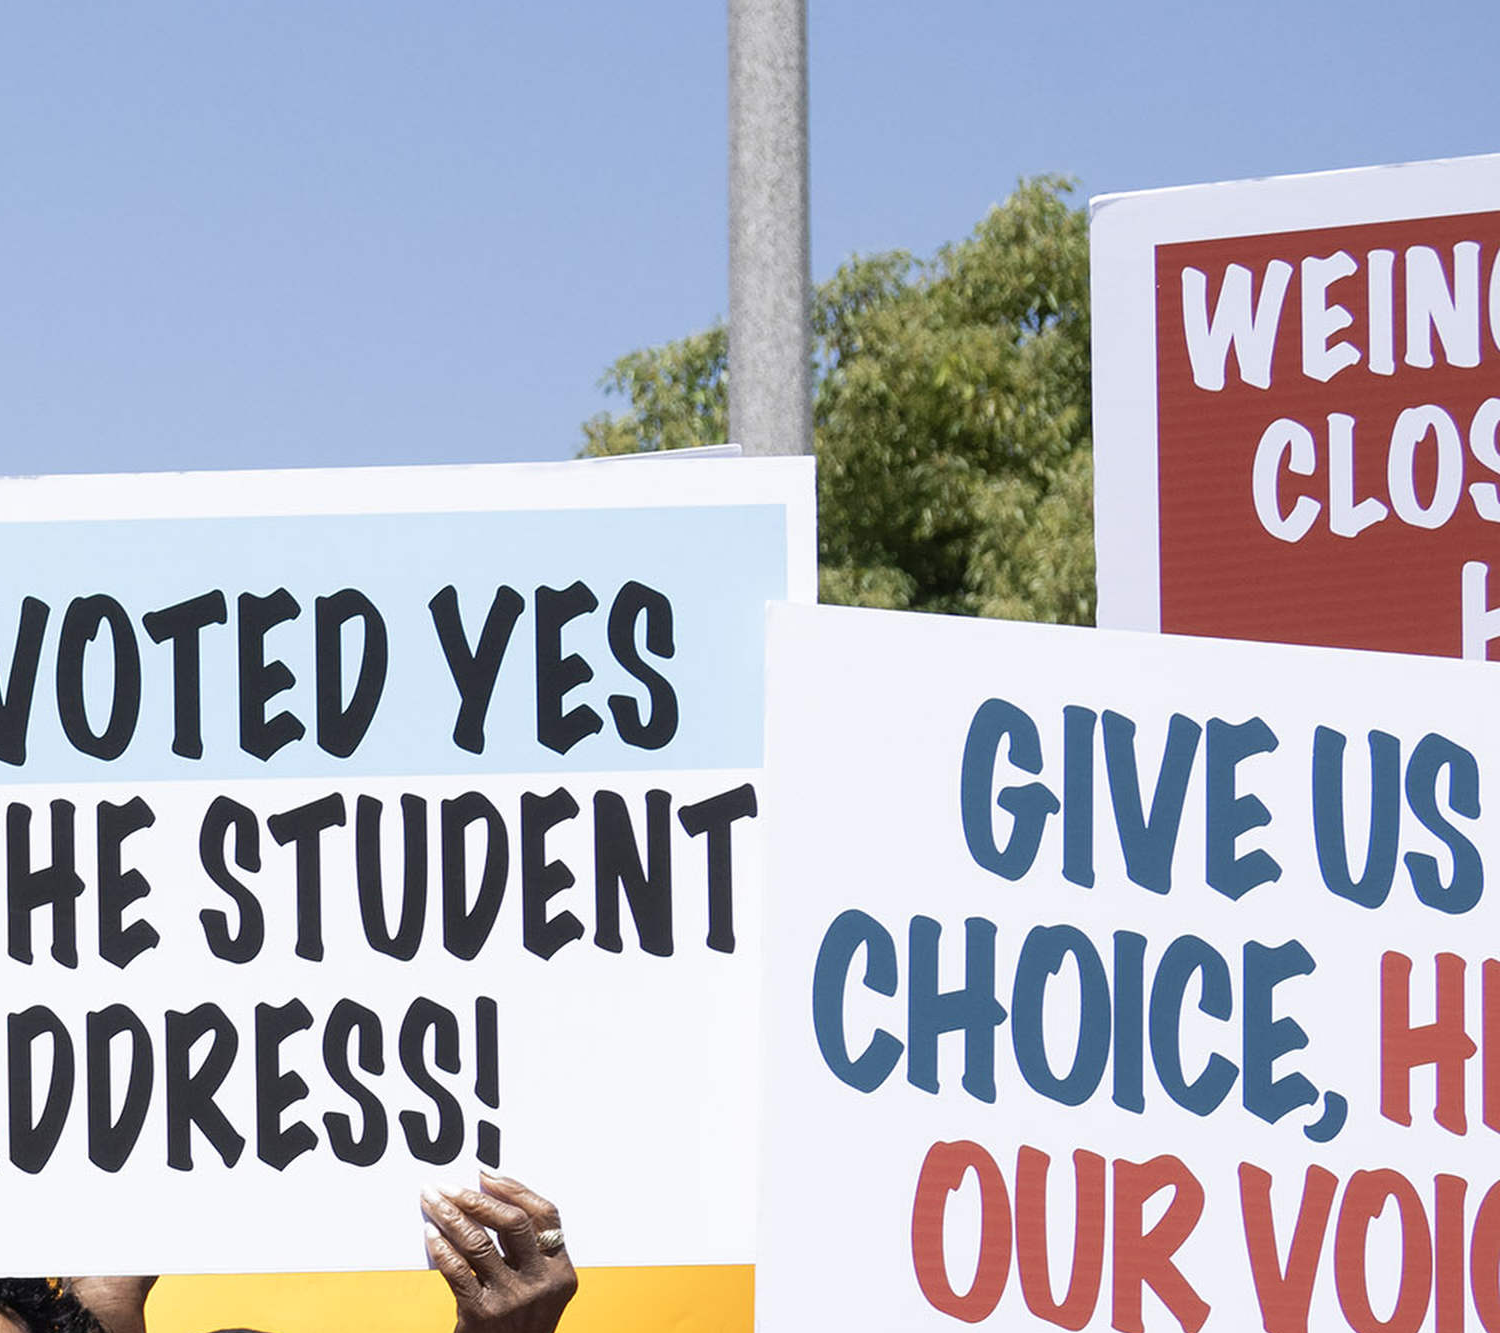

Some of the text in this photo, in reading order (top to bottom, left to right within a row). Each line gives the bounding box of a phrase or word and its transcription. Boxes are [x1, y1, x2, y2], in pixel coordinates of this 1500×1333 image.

[1182, 240, 1500, 392] WEIN
[428, 580, 678, 755] YES
[197, 781, 758, 964] STUDENT
[961, 699, 1483, 914] GIVE US
[813, 910, 1347, 1142] CHOICE,
